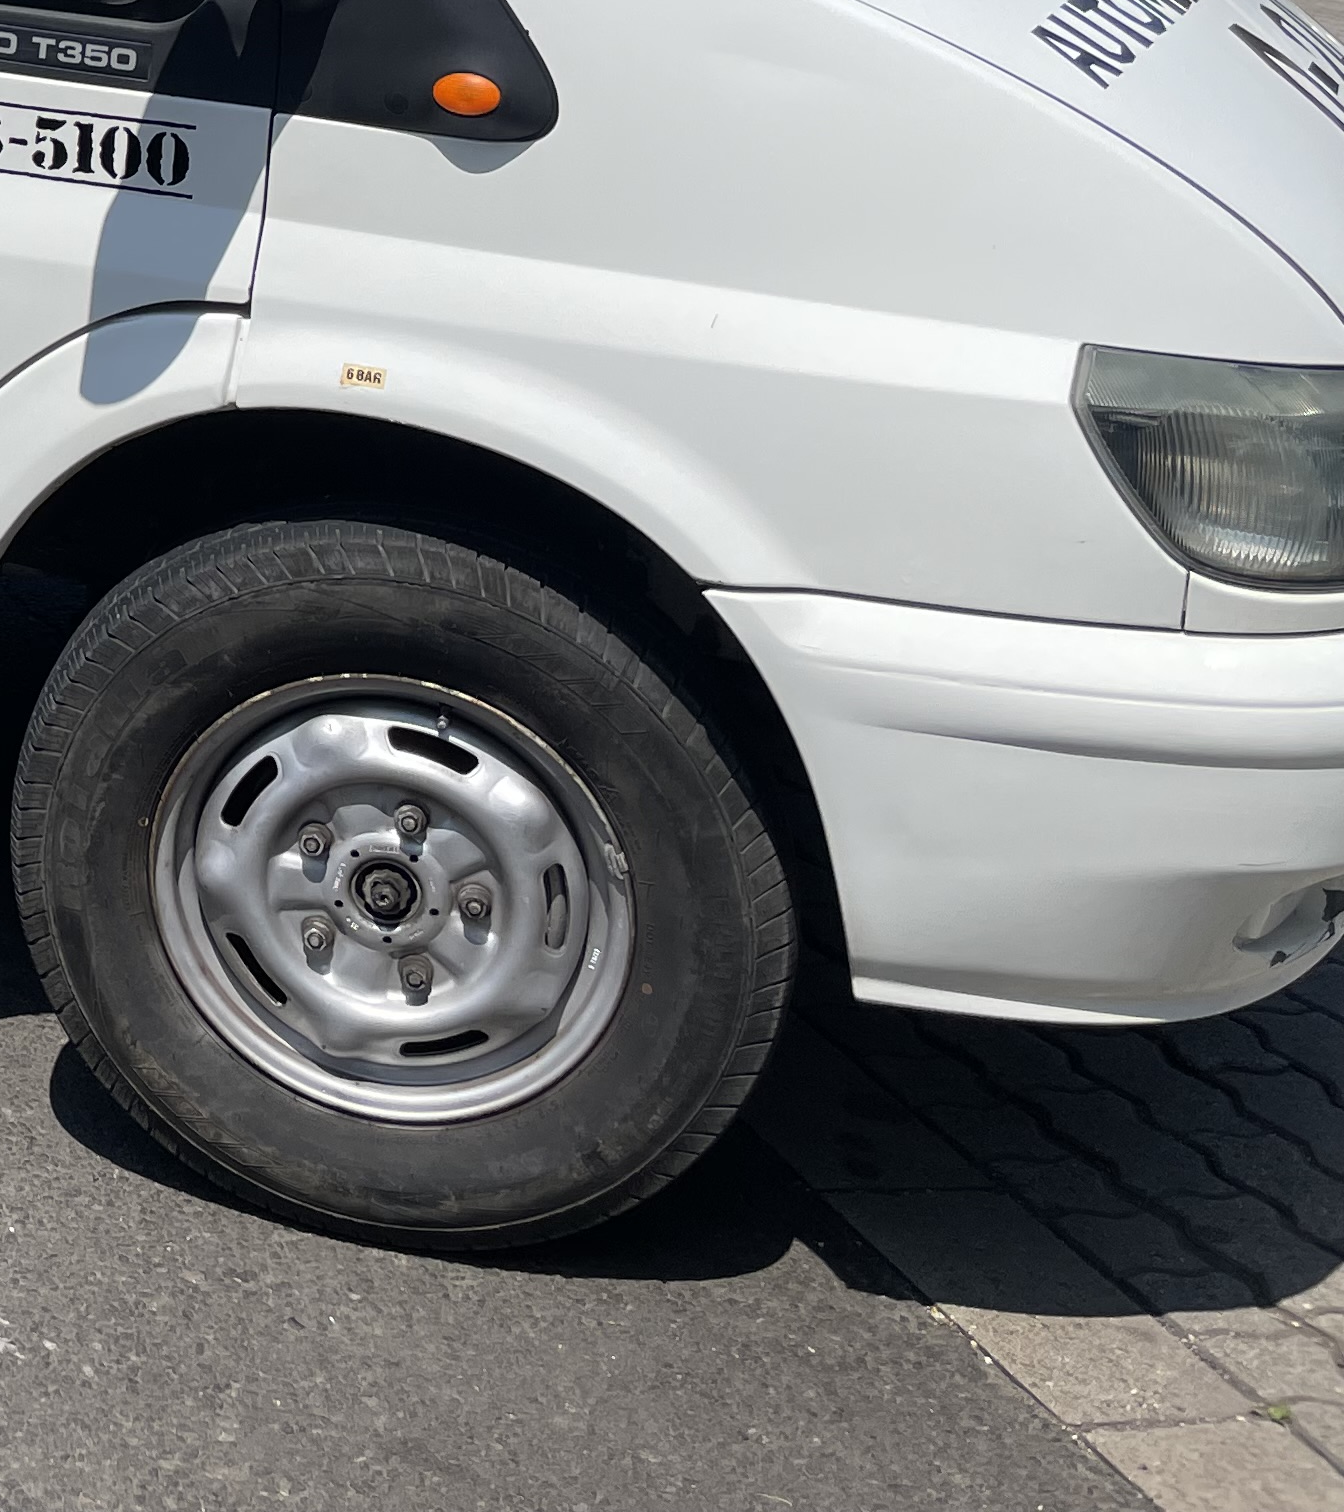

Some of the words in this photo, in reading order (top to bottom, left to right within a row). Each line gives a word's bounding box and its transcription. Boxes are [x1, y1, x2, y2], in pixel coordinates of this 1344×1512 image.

[31, 35, 138, 72] T350
[346, 367, 355, 380] 6
[356, 369, 382, 384] BAR
